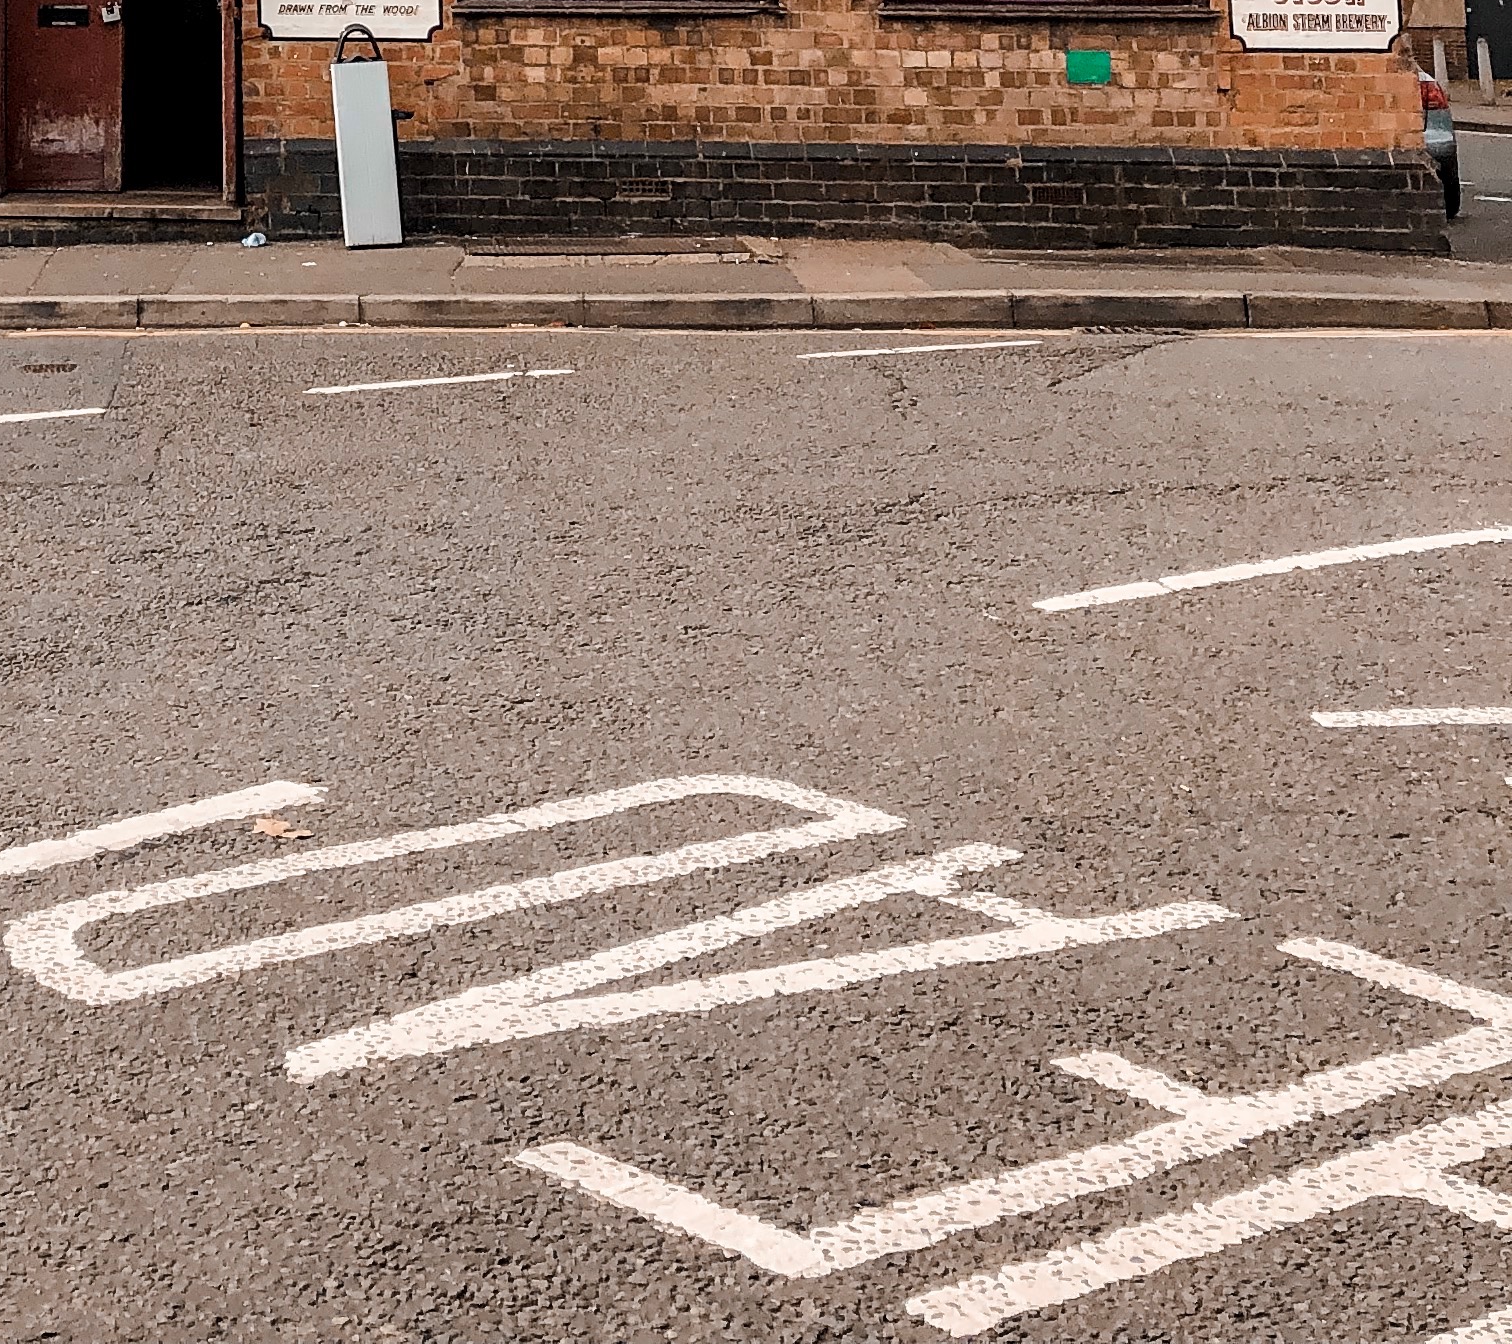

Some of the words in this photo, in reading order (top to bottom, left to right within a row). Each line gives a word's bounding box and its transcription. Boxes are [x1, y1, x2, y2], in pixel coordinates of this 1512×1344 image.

[278, 3, 315, 16] DRAWN
[318, 3, 349, 16] FROM
[355, 3, 378, 16] THE
[1246, 12, 1289, 32] ALBION
[1292, 13, 1333, 32] STEAM
[1335, 14, 1388, 33] BREWERY
